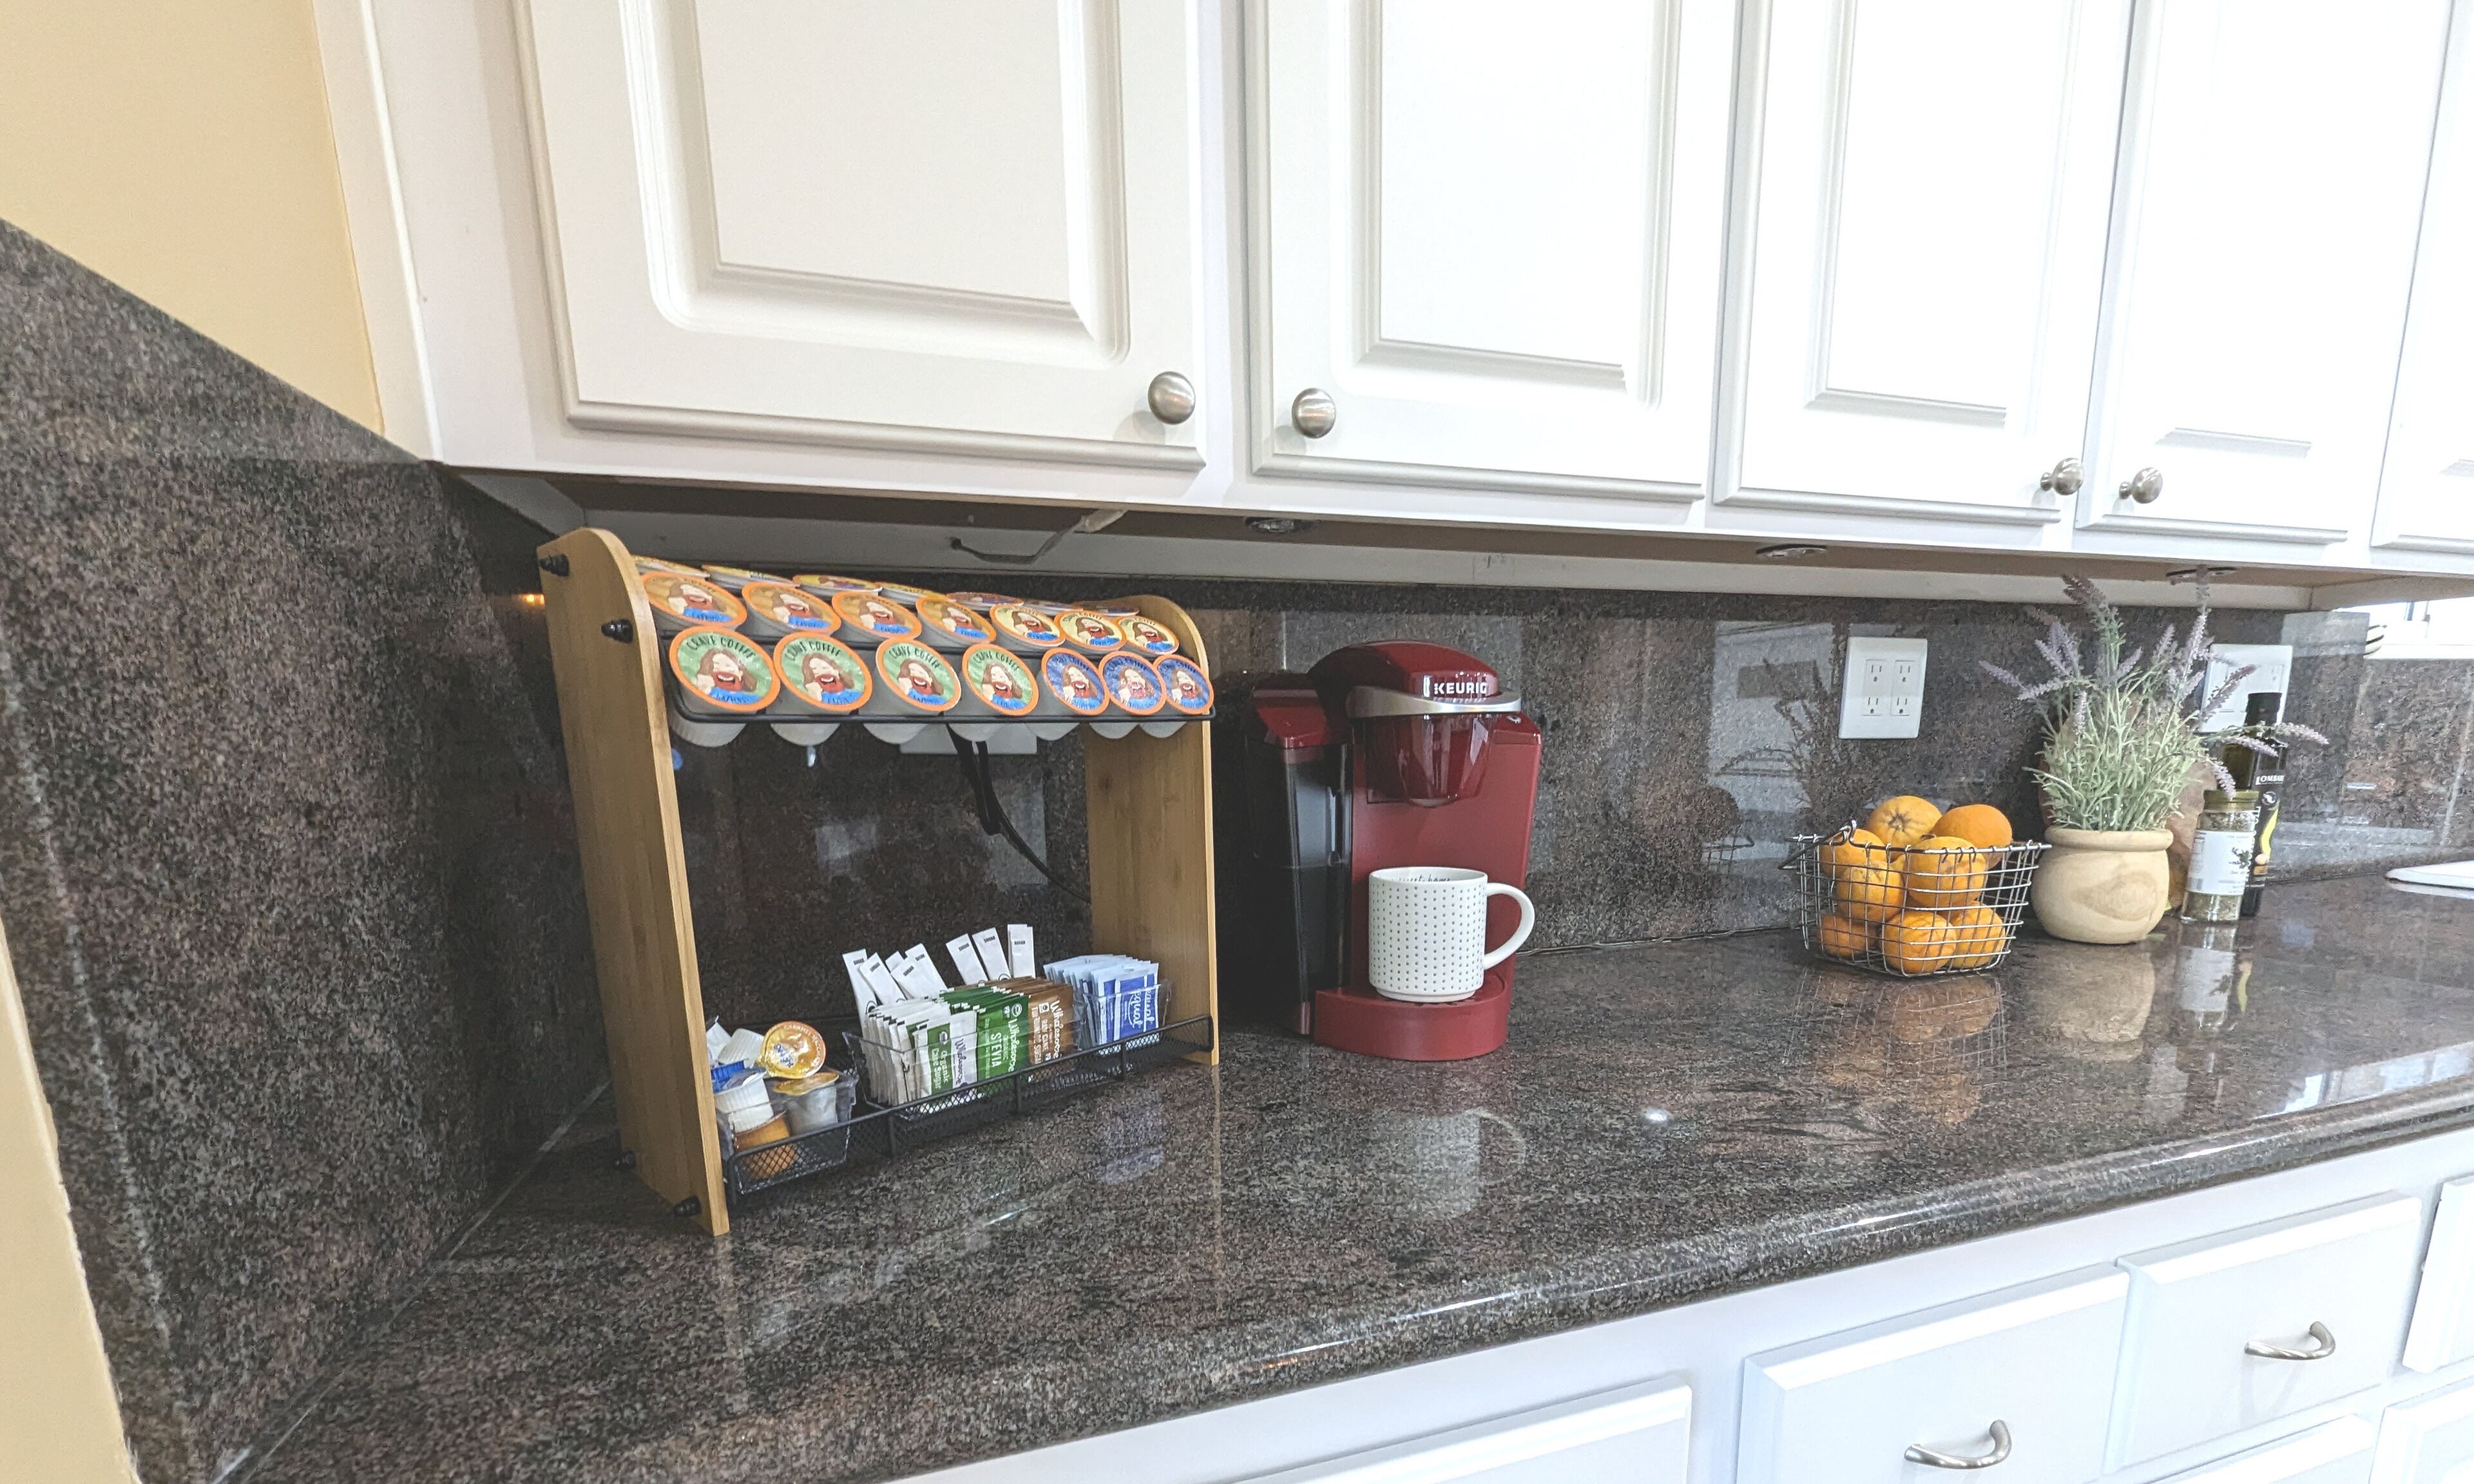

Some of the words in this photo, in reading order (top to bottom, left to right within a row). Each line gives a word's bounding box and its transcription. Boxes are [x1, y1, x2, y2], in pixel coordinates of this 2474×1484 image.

[1434, 681, 1487, 694] KEURIG
[991, 1032, 1002, 1067] STEVIA
[1008, 1018, 1020, 1072] Wholesome
[1050, 1000, 1064, 1059] Wholesome
[939, 1051, 950, 1083] Organic
[955, 1038, 966, 1085] Wholesome
